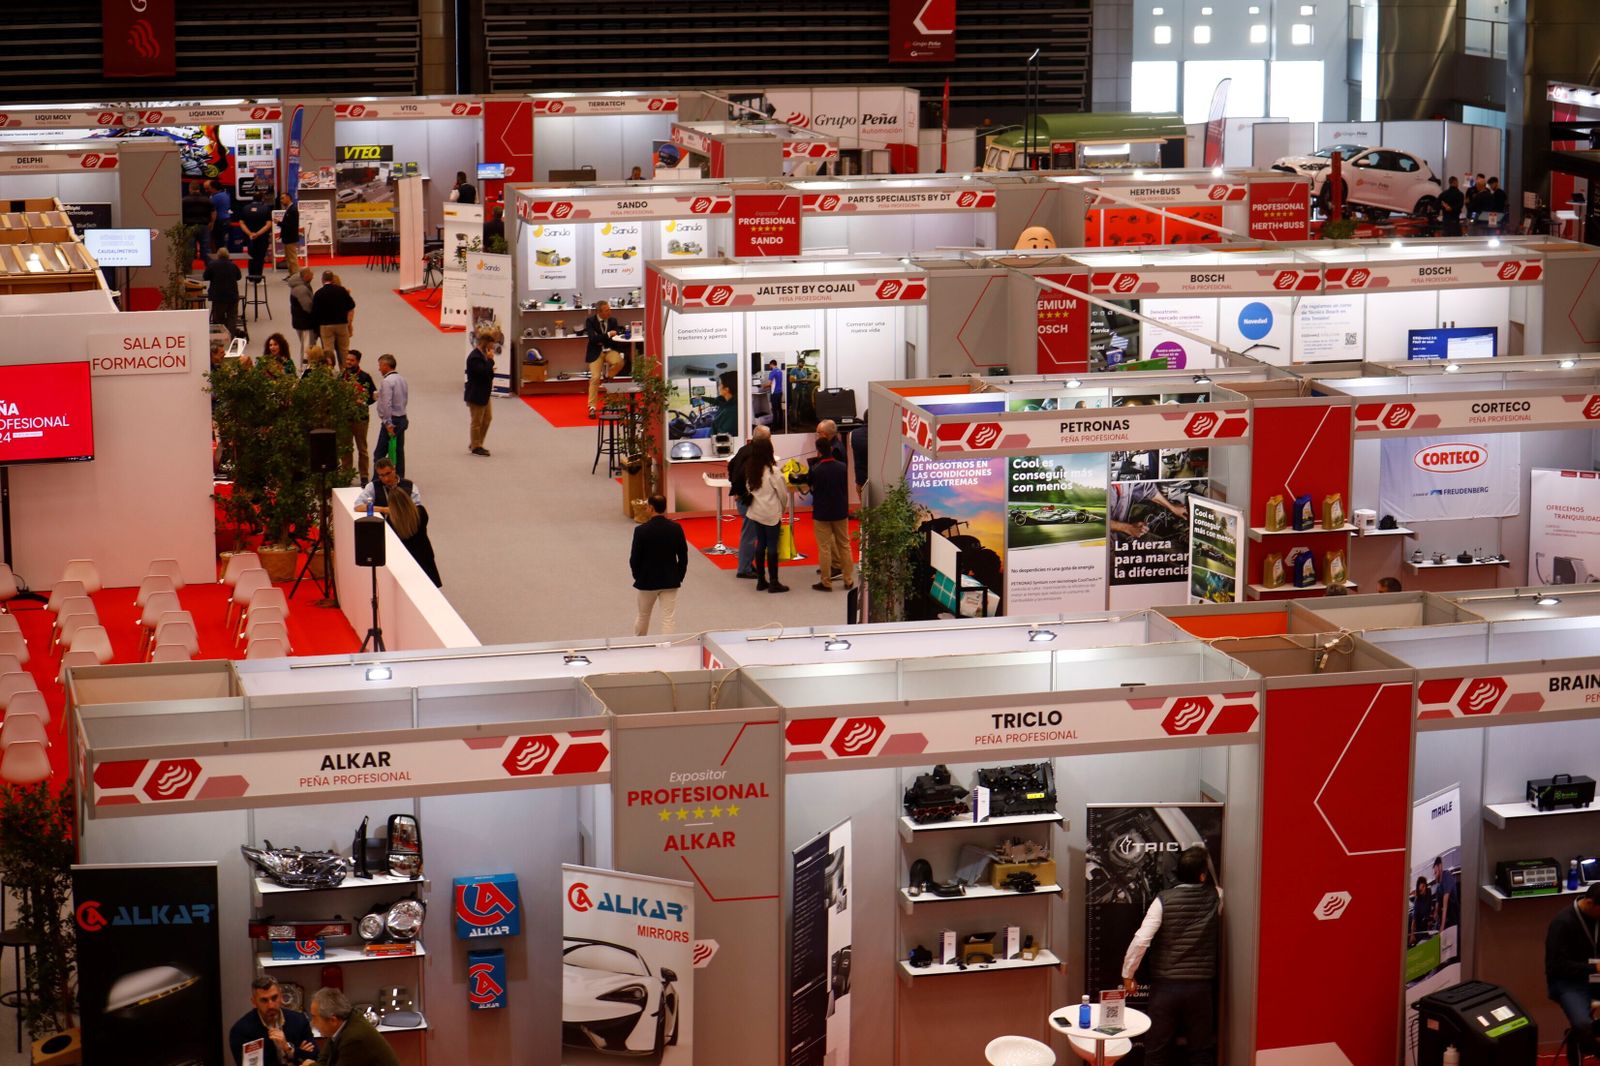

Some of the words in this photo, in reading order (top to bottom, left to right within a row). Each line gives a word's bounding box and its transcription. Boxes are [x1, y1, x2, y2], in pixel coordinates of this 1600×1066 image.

[814, 114, 856, 130] Grupo
[861, 112, 898, 126] Peña
[344, 146, 382, 160] VTEQ
[1130, 188, 1181, 196] HERTH+BUSS
[1252, 203, 1304, 211] PROFESIONAL
[612, 226, 639, 235] Sando
[676, 223, 702, 232] Sando
[1252, 221, 1304, 230] HERTH+BUSS
[544, 227, 570, 237] Sando
[751, 237, 784, 245] SANDO
[483, 262, 500, 272] Sando
[1419, 266, 1452, 276] BOSCH
[1190, 274, 1225, 283] BOSCH
[757, 285, 800, 295] JALTEST
[802, 285, 815, 294] BY
[817, 284, 855, 293] COJALI
[1037, 299, 1077, 310] EMIUM
[1038, 324, 1068, 334] OSCH
[123, 336, 161, 350] SALA
[166, 336, 186, 348] DE
[92, 352, 186, 370] FORMACIÓN
[0, 400, 19, 416] ÑA
[1472, 401, 1530, 414] CORTECO
[0, 415, 69, 430] OFESIONAL
[1490, 414, 1532, 423] PROFESIONAL
[1060, 419, 1130, 434] PETRONAS
[1061, 435, 1081, 443] PEÑA
[1082, 432, 1129, 442] PROFESIONAL
[1012, 458, 1039, 469] Cool
[1422, 450, 1480, 466] CORTECO
[926, 461, 974, 470] NOSOTROS
[930, 468, 992, 478] CONDICIONES
[1012, 471, 1067, 482] conseguir
[1070, 469, 1092, 478] más
[912, 479, 930, 488] MÁS
[932, 478, 978, 487] EXTREMAS
[1012, 484, 1034, 493] con
[1036, 482, 1073, 491] menos
[1444, 486, 1489, 496] FREUDENBERG
[1194, 508, 1208, 519] Cool
[1546, 504, 1585, 512] OFRECEMOS
[1194, 517, 1221, 532] conseguir
[1194, 526, 1206, 535] más
[1206, 530, 1216, 539] con
[1115, 540, 1130, 551] La
[1132, 539, 1172, 551] fuerza
[1114, 556, 1142, 567] para
[1145, 552, 1189, 563] marcar
[1114, 568, 1126, 578] la
[1128, 564, 1189, 578] diferencia
[992, 710, 1063, 730] TRICLO
[974, 733, 1003, 745] PEÑA
[1005, 729, 1078, 744] PROFESIONAL
[320, 751, 391, 771] ALKAR
[300, 776, 330, 788] PEÑA
[333, 770, 412, 786] PROFESIONAL
[669, 769, 727, 785] Expositor
[627, 782, 769, 807] PROFESIONAL
[1431, 801, 1453, 820] MAHLE
[664, 831, 736, 852] ALKAR
[597, 892, 684, 922] ALKAR
[112, 904, 210, 926] ALKAR
[469, 926, 510, 937] ALKAR
[637, 925, 689, 943] MIRRORS
